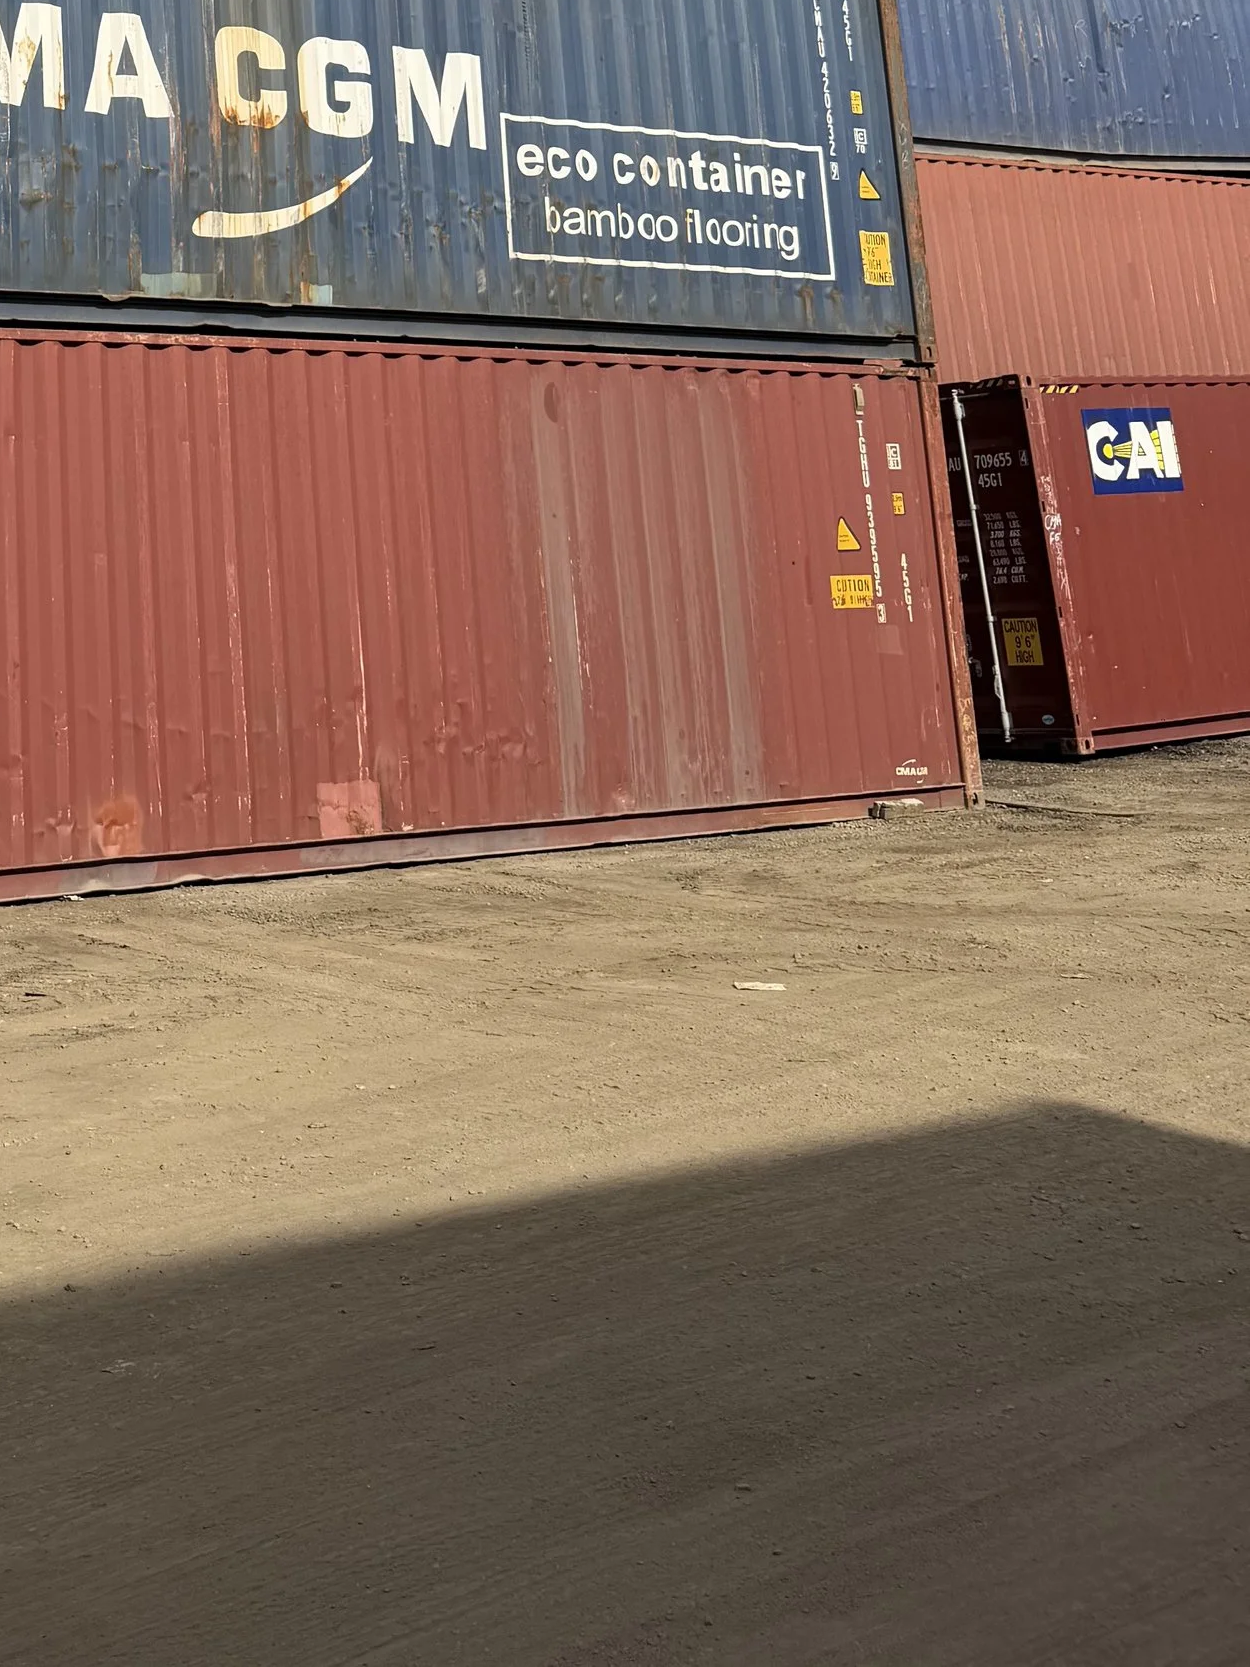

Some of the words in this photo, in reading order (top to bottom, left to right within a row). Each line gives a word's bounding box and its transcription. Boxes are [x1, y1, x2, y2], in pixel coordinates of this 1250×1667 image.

[842, 0, 853, 61] 45G1
[214, 26, 487, 151] CGM
[820, 61, 836, 157] 420632
[516, 142, 598, 182] eco
[613, 151, 806, 201] container
[545, 196, 678, 243] bamboo
[684, 207, 799, 261] flooring
[974, 452, 1012, 469] 709655
[1019, 450, 1029, 466] 4
[978, 473, 1002, 488] 45G1
[1086, 421, 1181, 481] CAI
[856, 420, 870, 487] TGHU
[865, 494, 883, 597] 939595
[876, 604, 886, 623] 3
[901, 554, 913, 622] 45G1
[1003, 620, 1037, 633] CAUTION
[1015, 650, 1034, 663] HIGH
